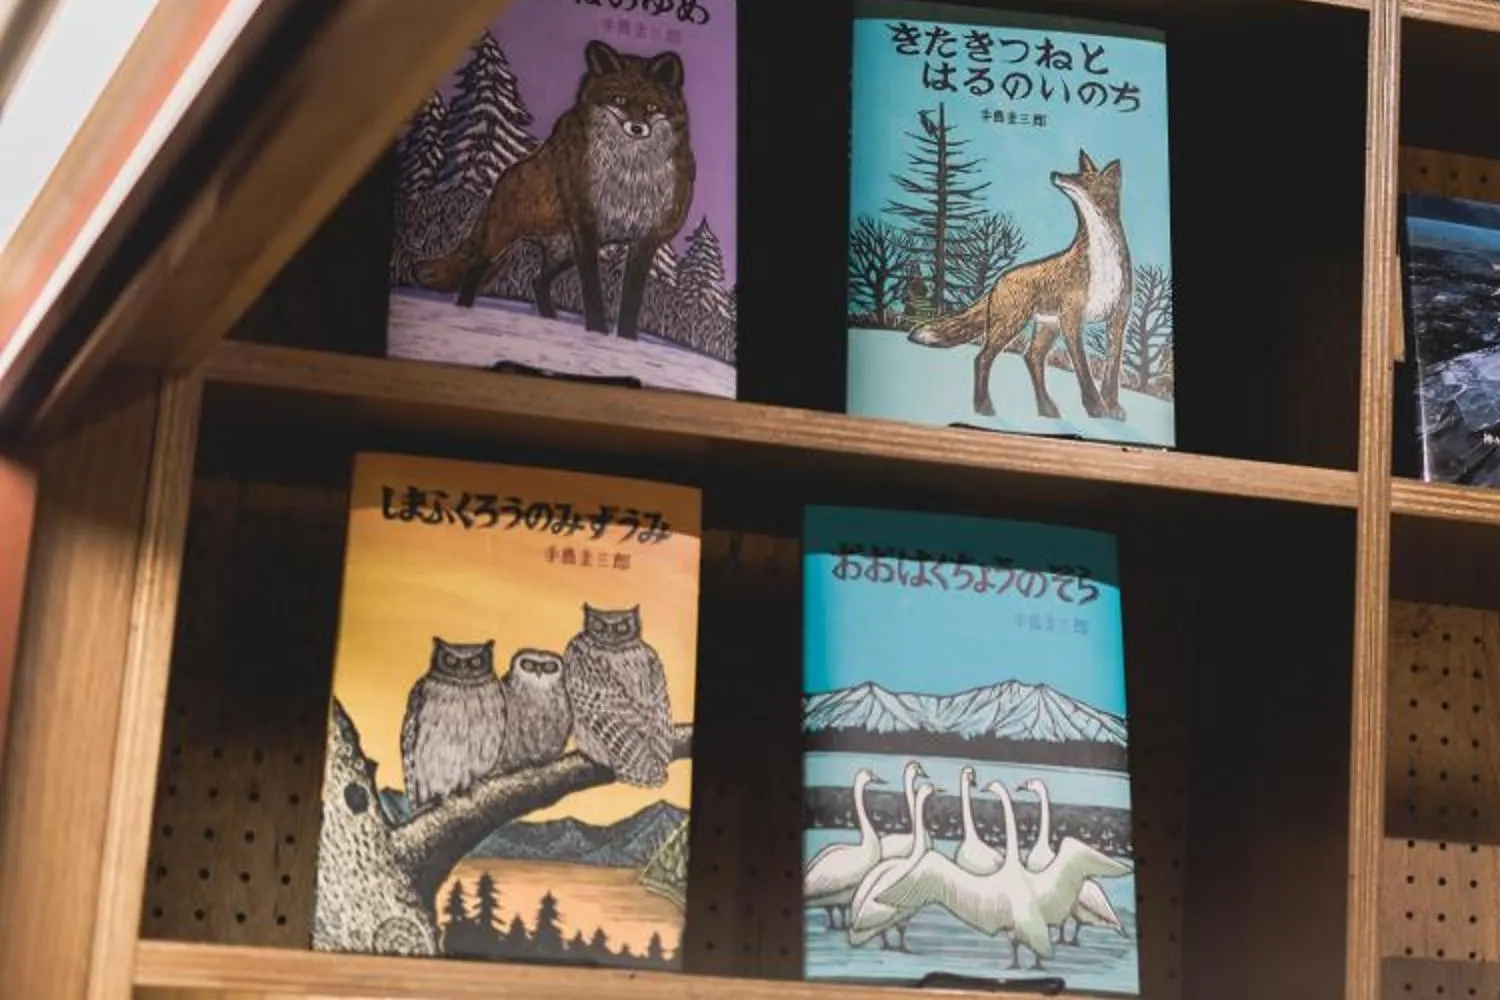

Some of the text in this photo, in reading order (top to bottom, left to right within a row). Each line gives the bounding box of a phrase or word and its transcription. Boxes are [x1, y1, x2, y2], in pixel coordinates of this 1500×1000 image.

[885, 22, 1109, 75] きたきつねと
[922, 61, 1142, 113] はるのいのち
[381, 484, 672, 544] しまふくろうのみずうみ
[831, 542, 1099, 605] おおはくちょうのそら
